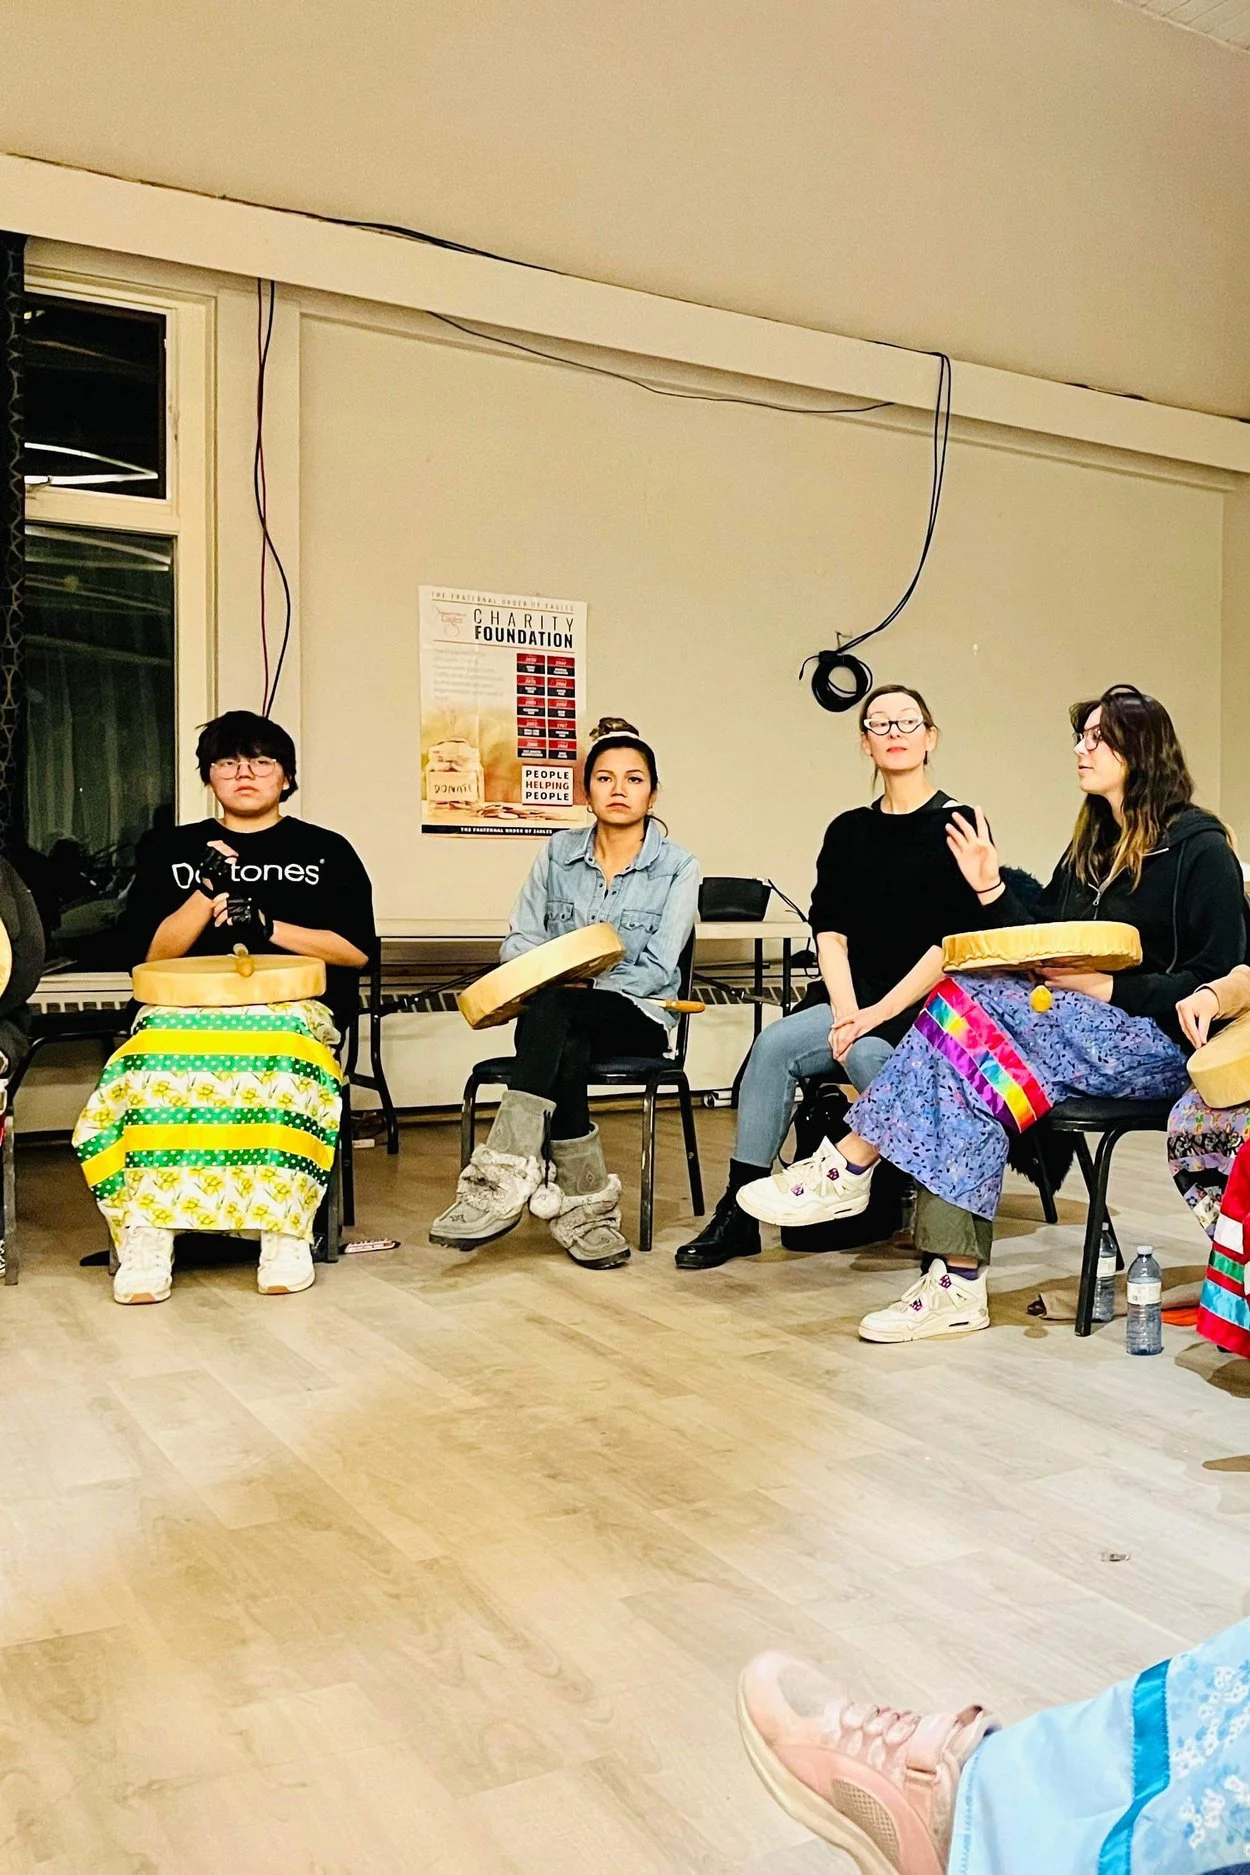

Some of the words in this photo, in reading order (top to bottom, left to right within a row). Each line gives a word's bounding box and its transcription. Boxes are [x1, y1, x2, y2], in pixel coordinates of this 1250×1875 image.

[473, 608, 574, 632] CHARITY
[474, 625, 573, 649] FOUNDATION
[525, 769, 569, 780] PEOPLE
[525, 780, 570, 790] HELPING
[525, 791, 569, 801] PEOPLE
[171, 862, 320, 890] Dtones
